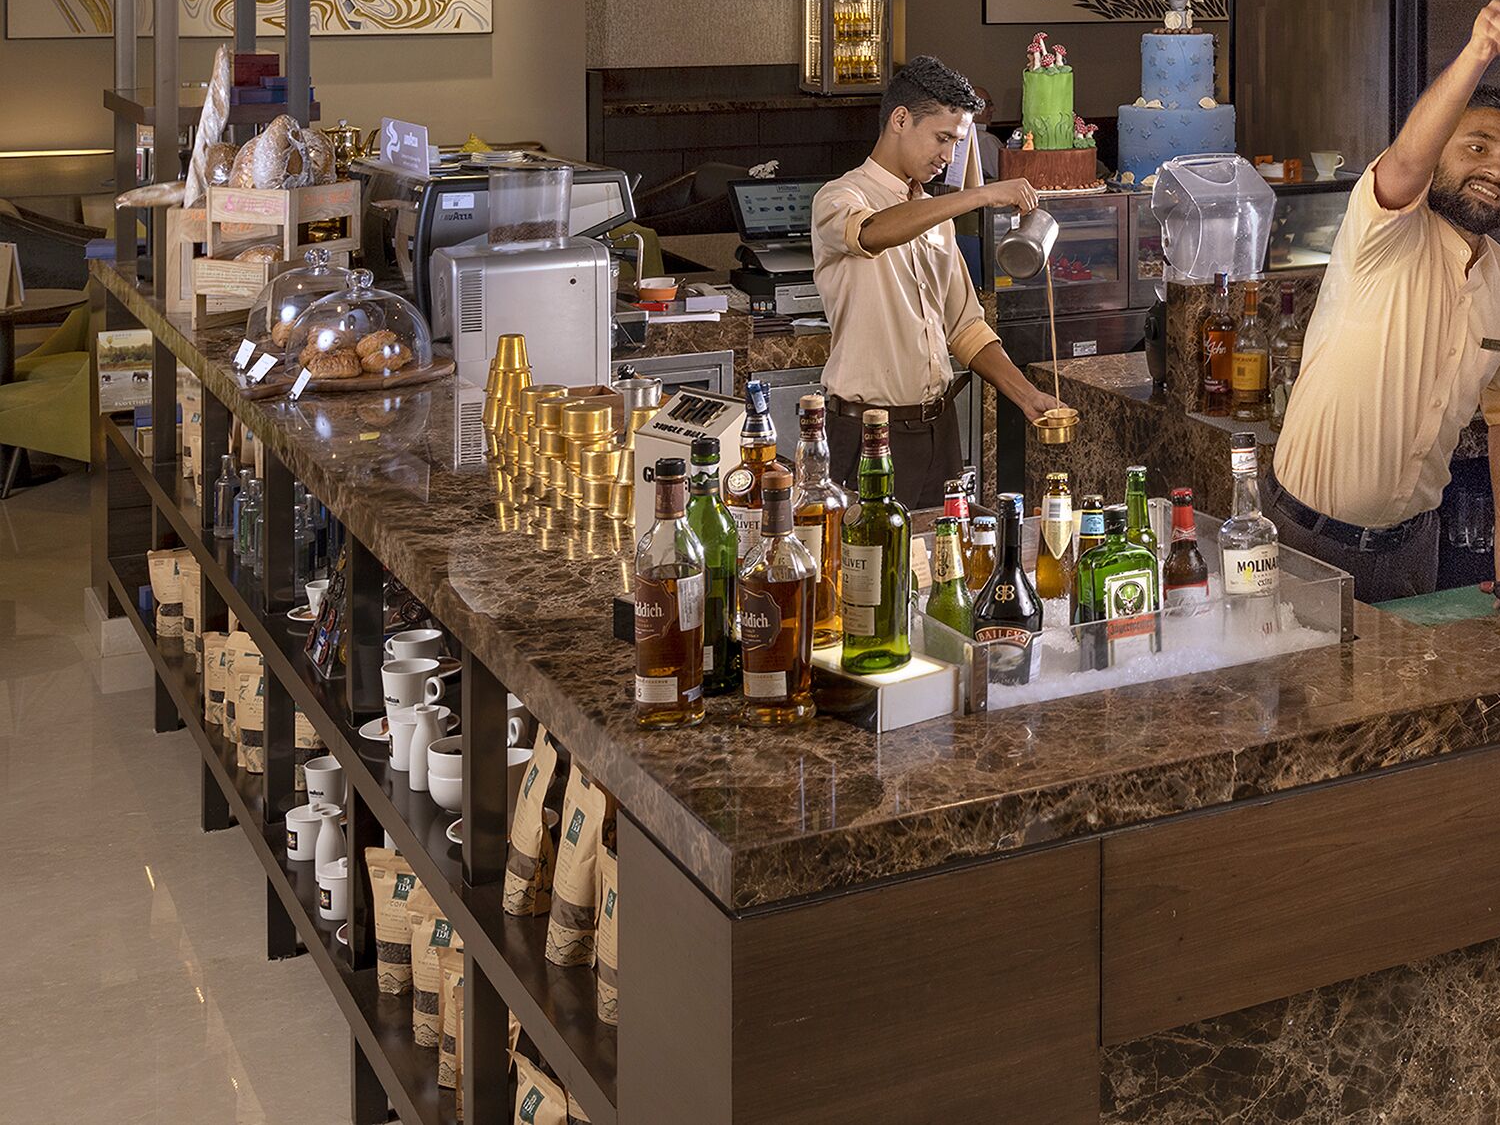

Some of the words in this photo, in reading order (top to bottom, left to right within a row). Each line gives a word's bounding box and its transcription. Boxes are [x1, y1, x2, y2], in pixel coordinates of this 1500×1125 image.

[666, 393, 732, 428] THE
[652, 421, 684, 435] SINGLE
[977, 629, 1029, 643] BAILEYS
